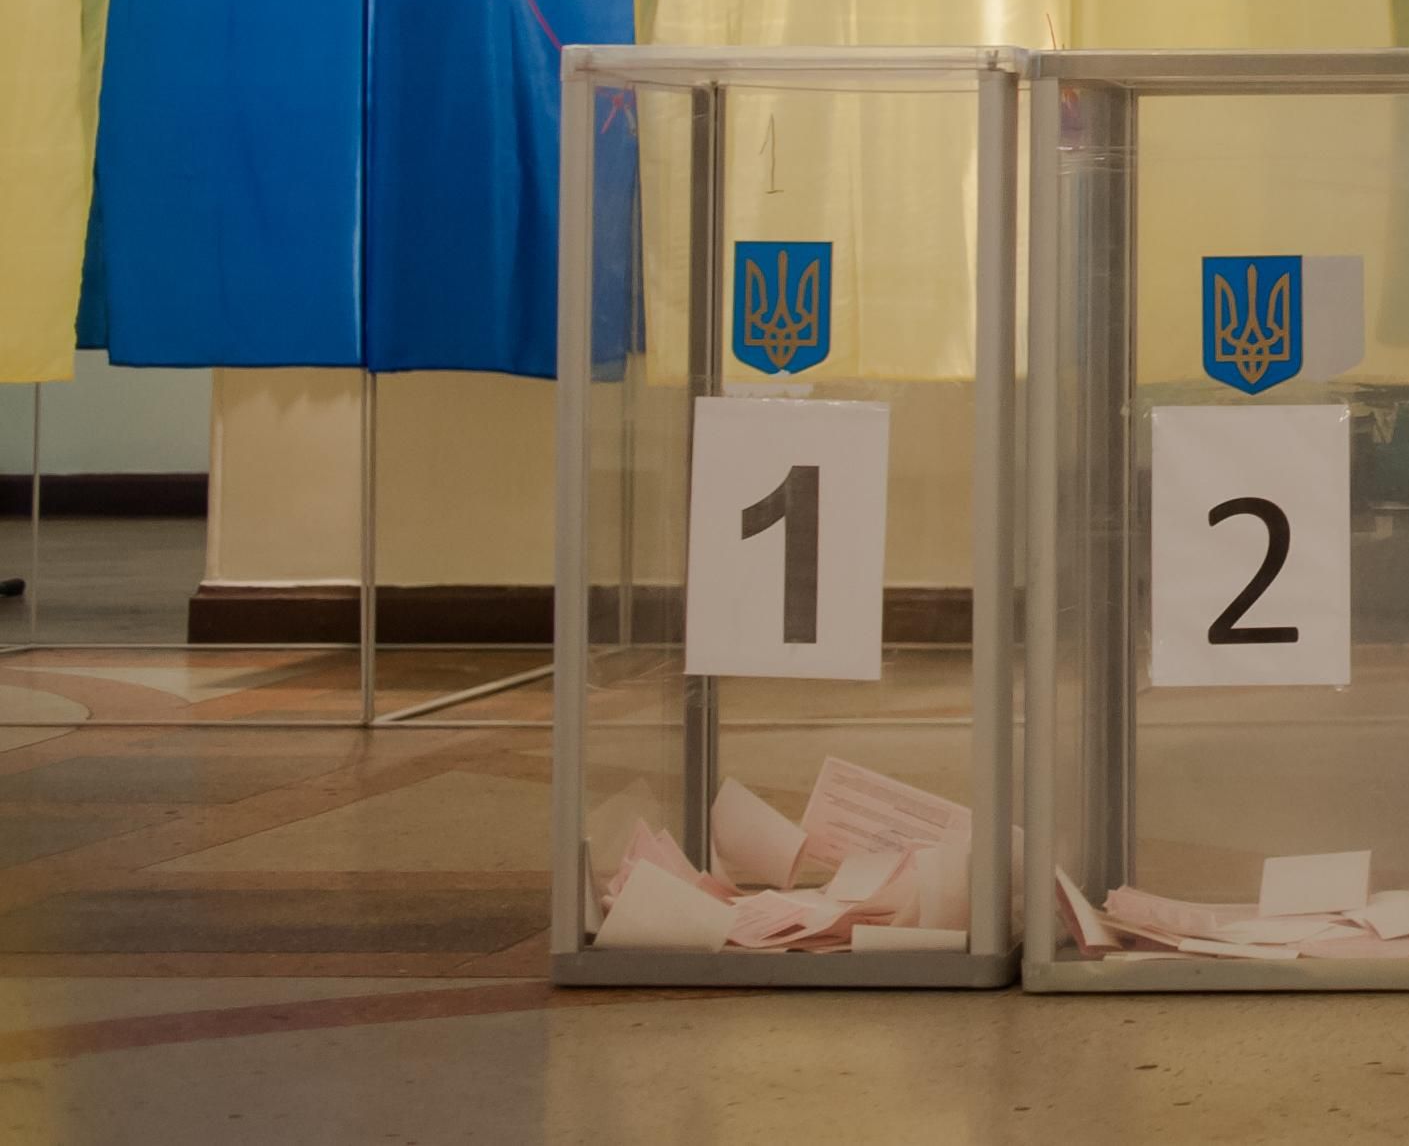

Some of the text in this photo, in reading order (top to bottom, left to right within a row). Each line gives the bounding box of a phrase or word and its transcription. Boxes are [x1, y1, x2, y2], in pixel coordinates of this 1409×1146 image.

[758, 113, 785, 194] 1
[741, 465, 820, 644] 1
[1207, 497, 1300, 645] 2
